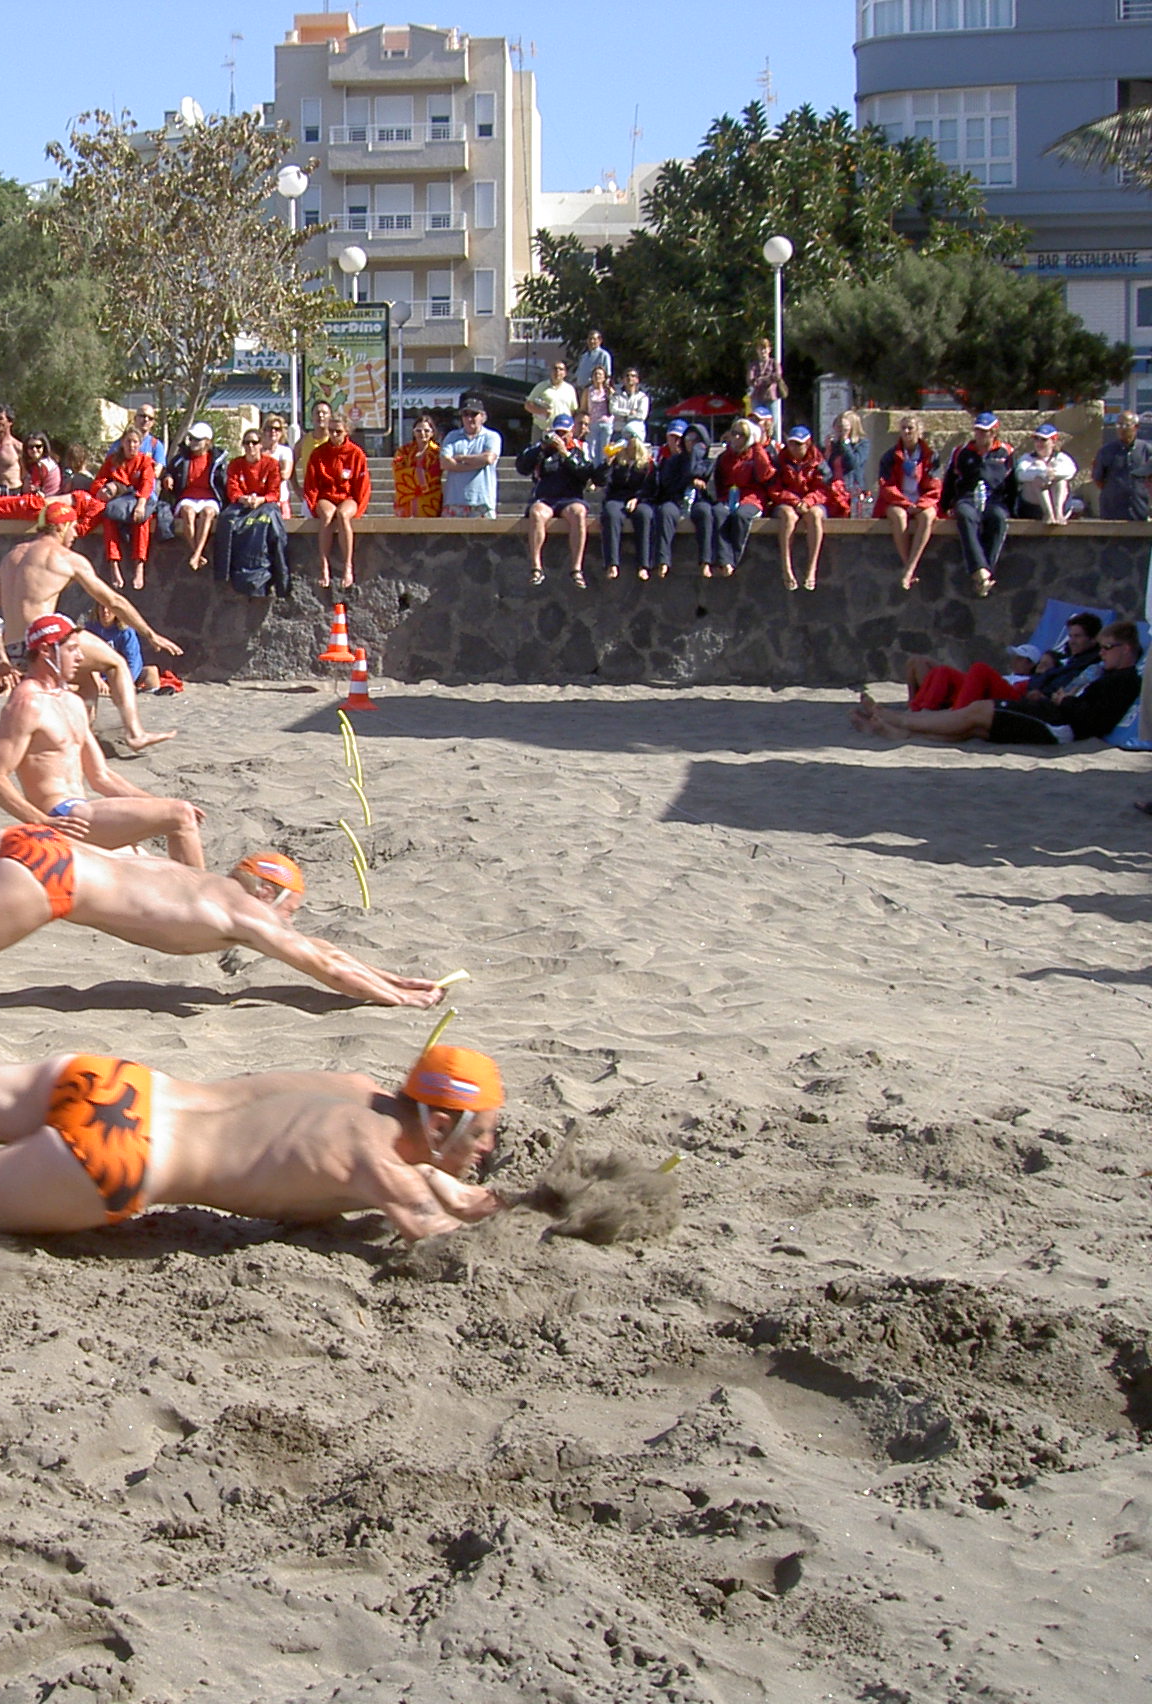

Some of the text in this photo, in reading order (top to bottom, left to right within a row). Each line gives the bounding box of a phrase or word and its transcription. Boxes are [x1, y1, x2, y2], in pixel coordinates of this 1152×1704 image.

[1038, 252, 1138, 270] BAR RESTAURANTE
[318, 310, 384, 319] PERMARKET
[323, 322, 383, 334] perDino
[237, 359, 285, 367] PLAZA
